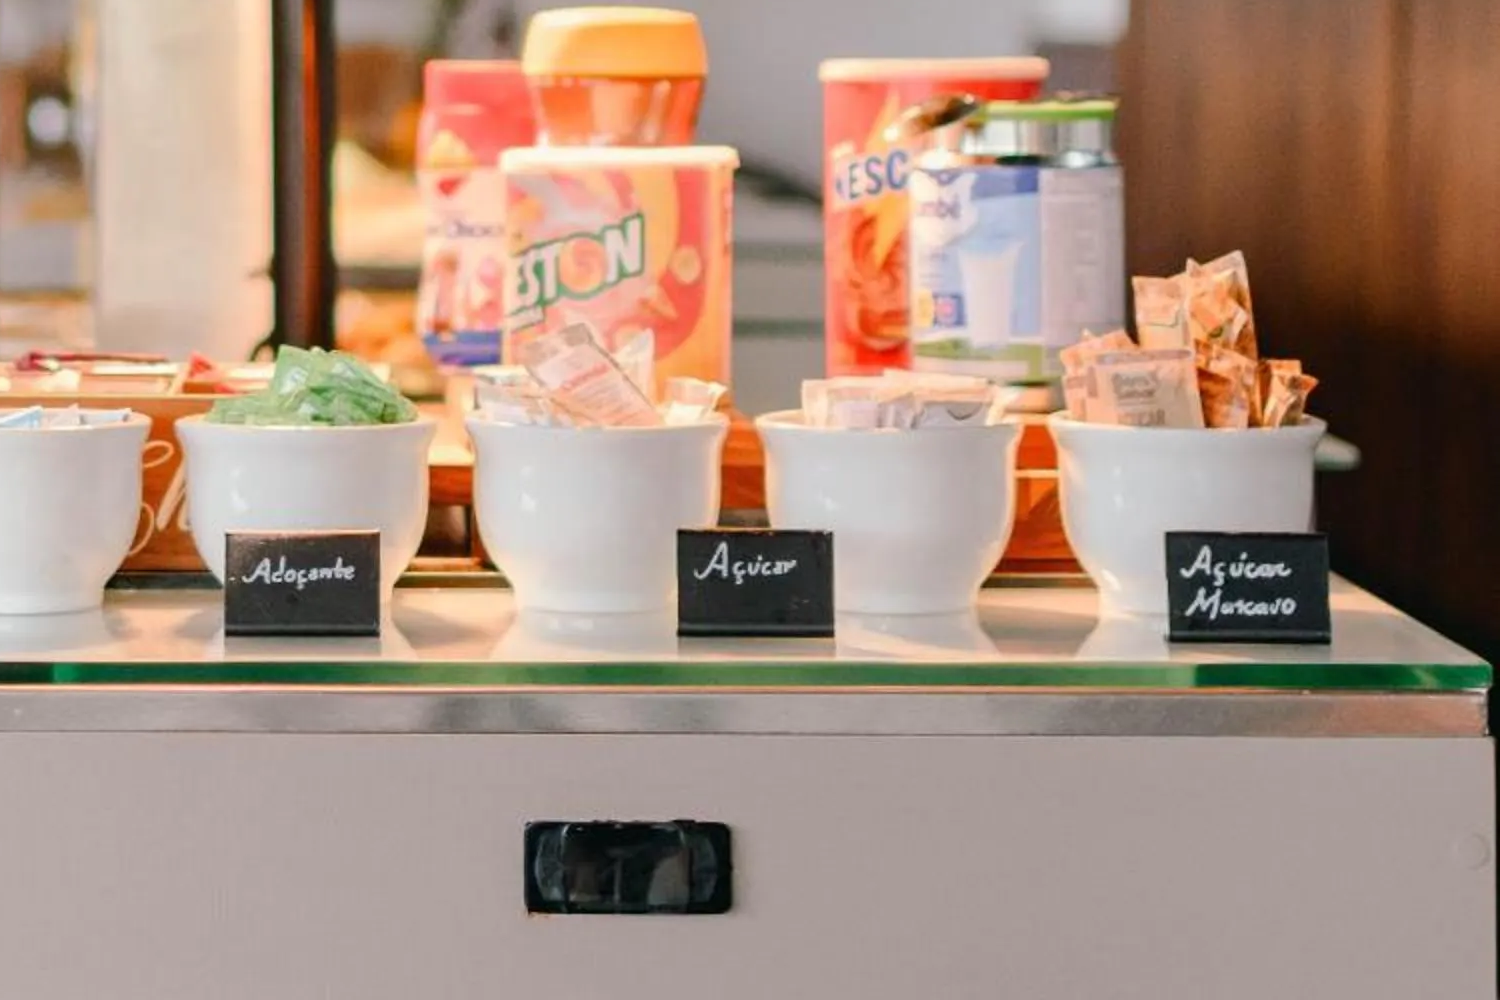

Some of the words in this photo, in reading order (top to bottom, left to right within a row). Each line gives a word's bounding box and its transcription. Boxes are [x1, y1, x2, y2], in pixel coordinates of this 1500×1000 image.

[510, 216, 644, 311] STON
[241, 555, 356, 591] Adoçante
[693, 541, 797, 585] Açúcar
[1179, 545, 1292, 587] Açúcar
